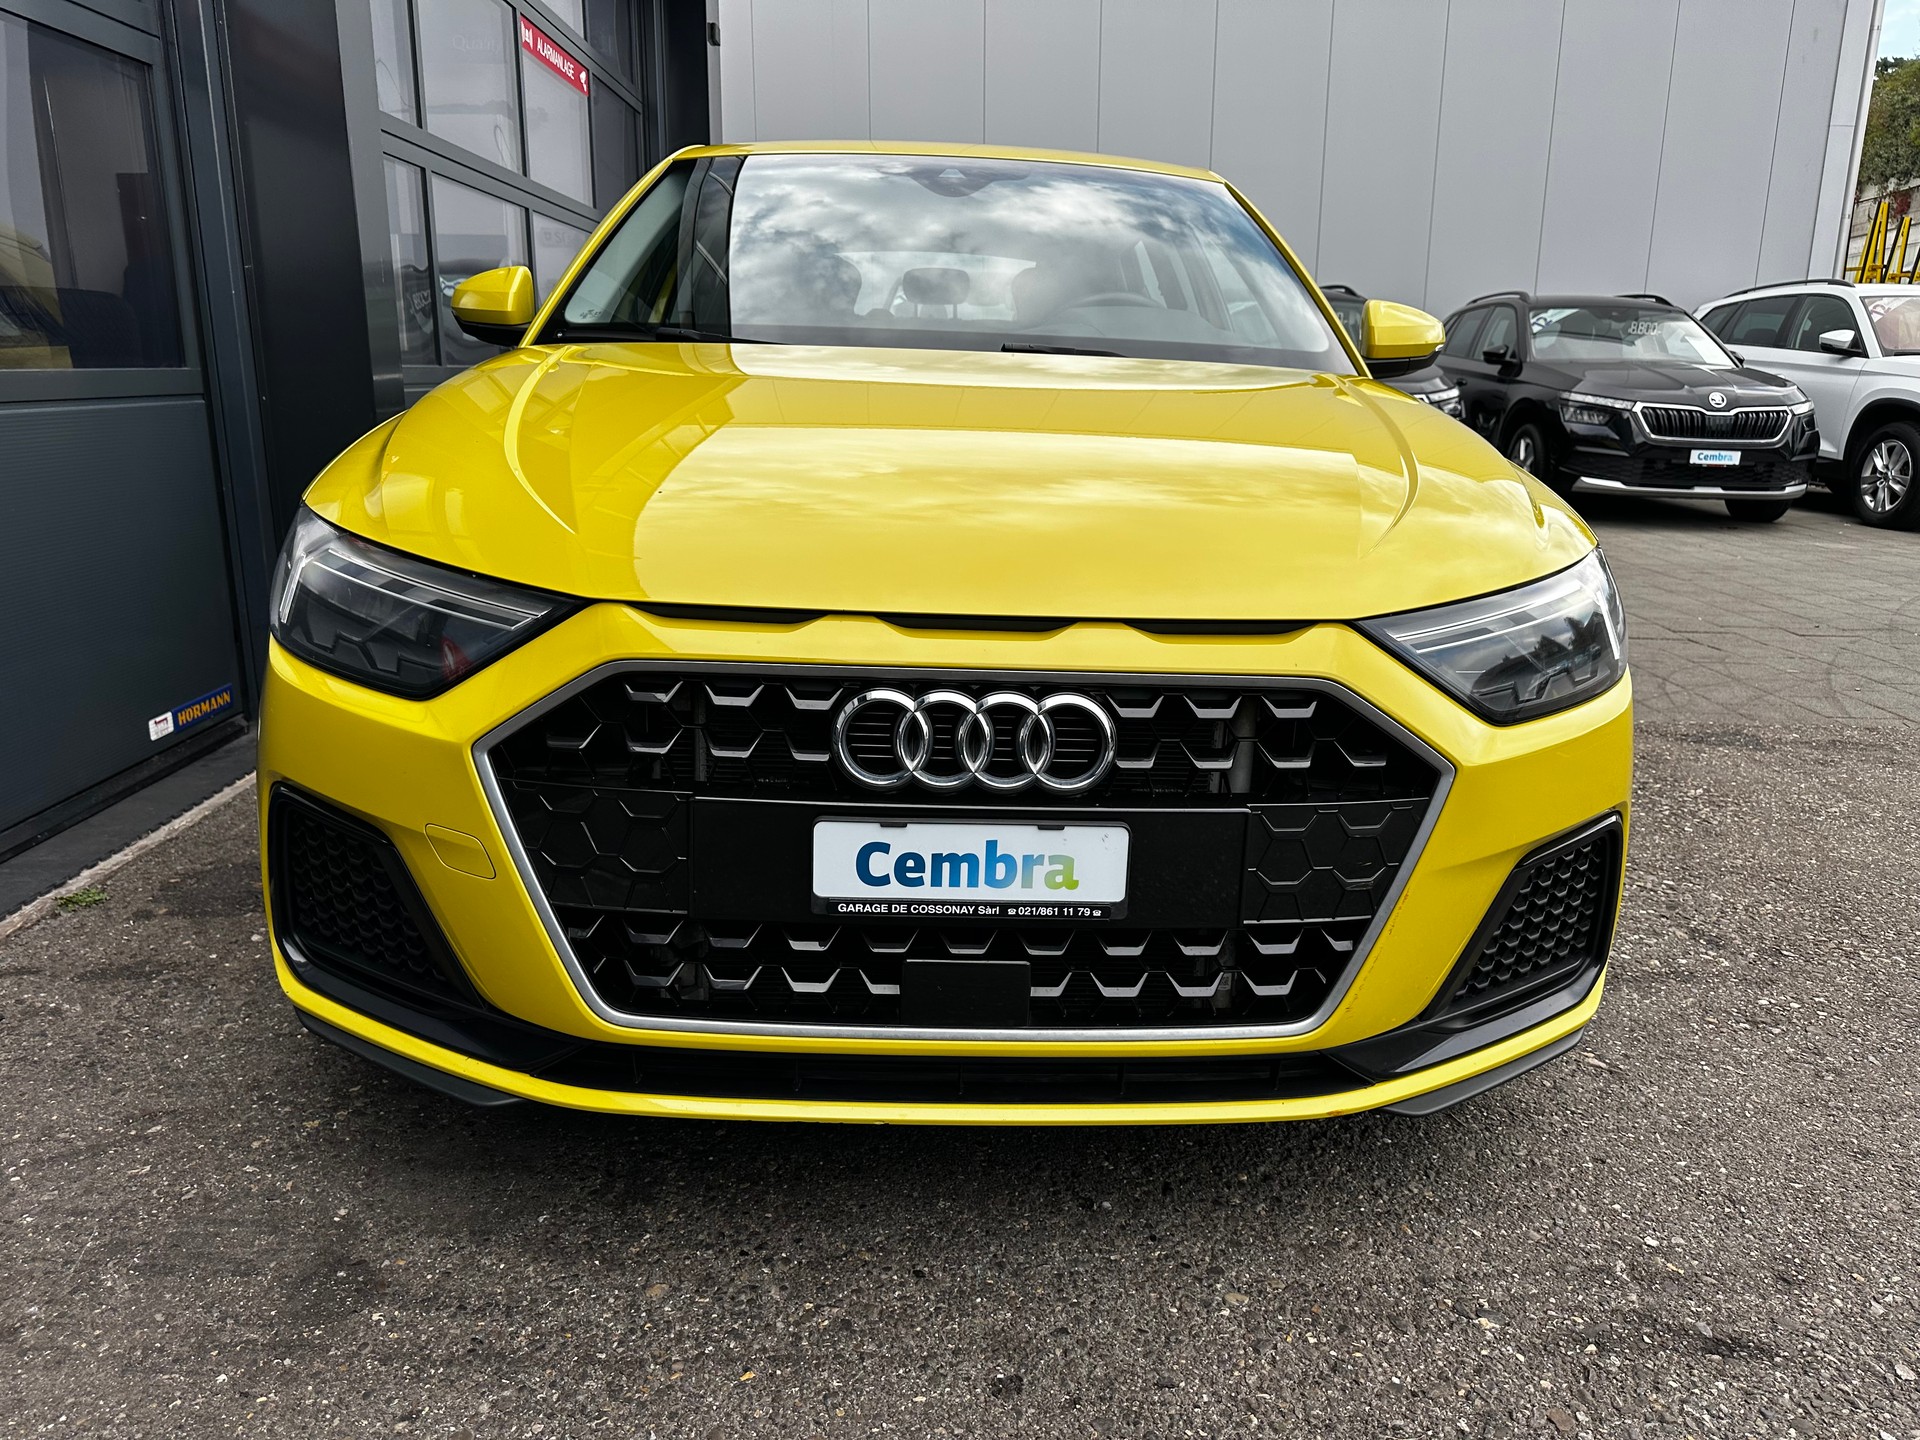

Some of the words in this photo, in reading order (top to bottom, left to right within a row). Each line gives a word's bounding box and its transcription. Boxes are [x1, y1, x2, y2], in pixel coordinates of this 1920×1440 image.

[536, 36, 575, 81] ALARMANLAGE
[1697, 452, 1733, 462] Cembra
[855, 839, 1080, 891] Cembra
[837, 903, 889, 913] GARAGE
[891, 904, 908, 913] DE
[910, 904, 976, 914] COSSONAY
[978, 905, 1000, 915] Sàrl
[1017, 906, 1059, 916] 021/861
[1062, 907, 1074, 916] 11
[1077, 907, 1091, 917] 79
